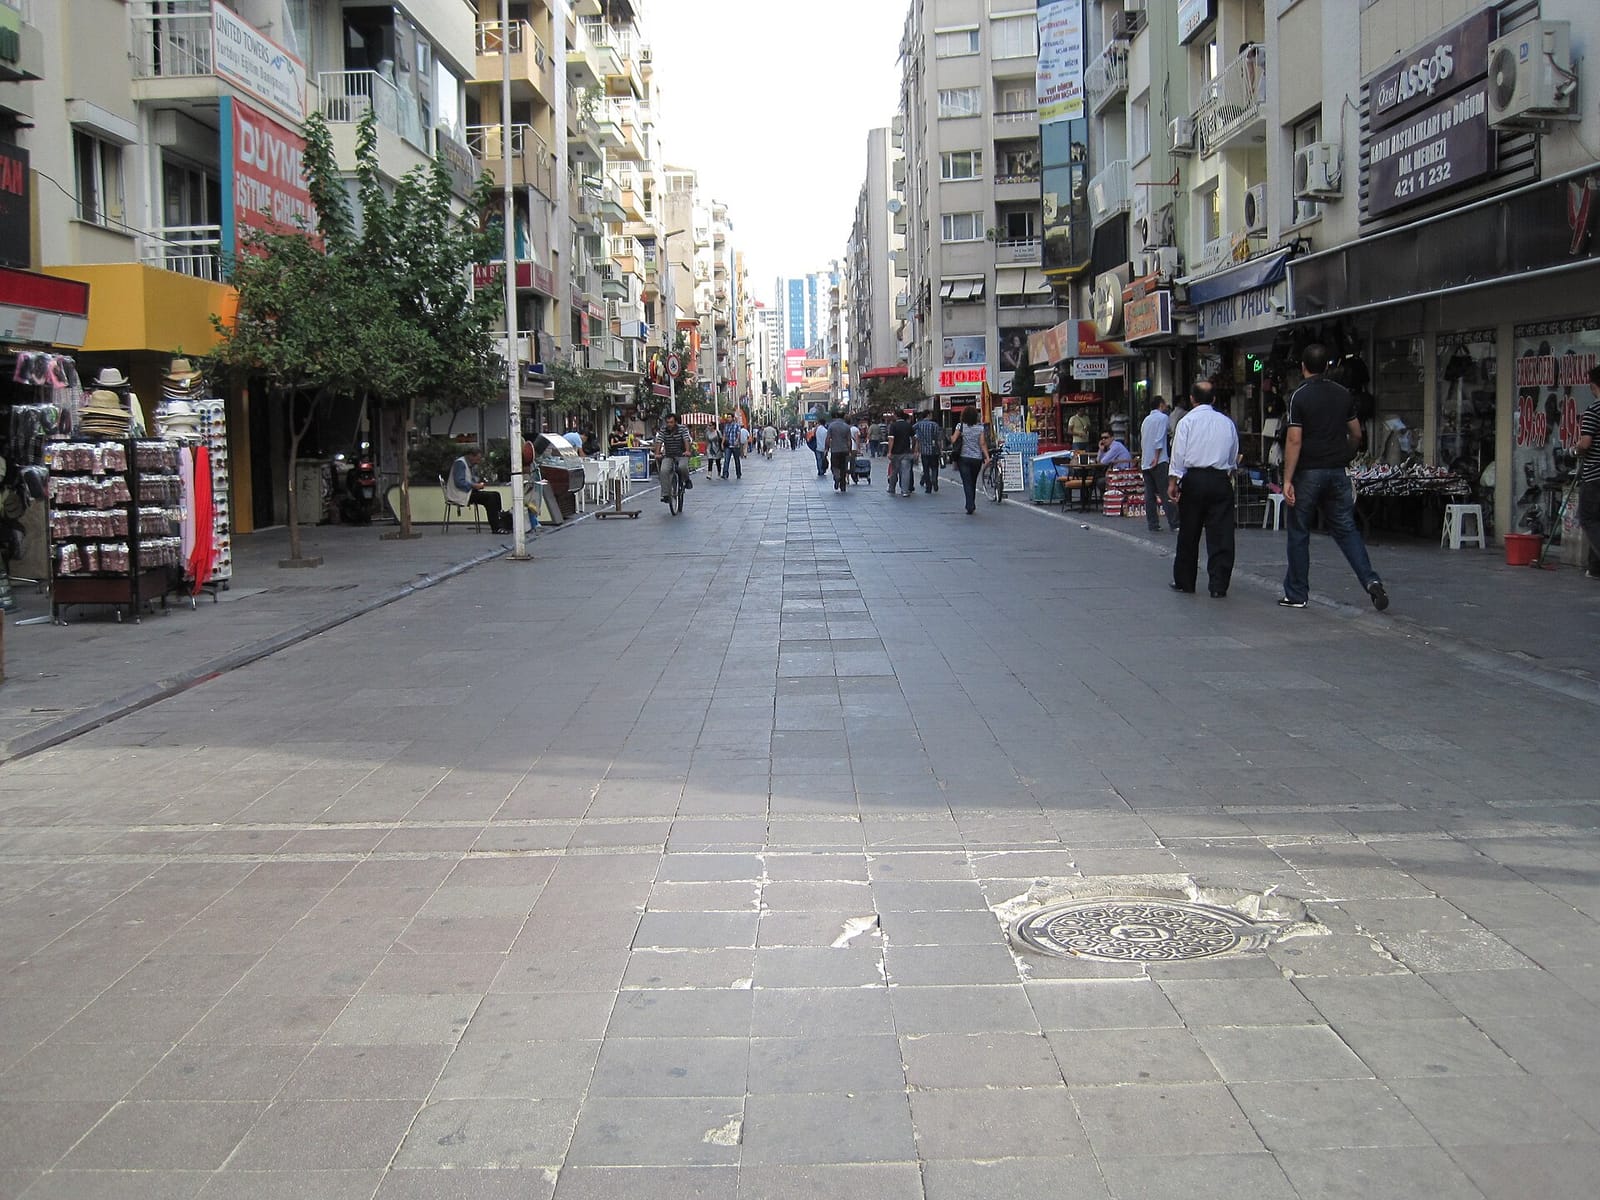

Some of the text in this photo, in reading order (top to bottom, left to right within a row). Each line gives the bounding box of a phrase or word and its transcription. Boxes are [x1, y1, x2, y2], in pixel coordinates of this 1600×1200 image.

[215, 12, 270, 64] UNITED TOWERS
[1378, 81, 1397, 107] Özel
[1370, 138, 1391, 165] KADIN
[1391, 113, 1441, 156] HASTALIKLARI
[1452, 91, 1485, 126] DOĞUM
[240, 119, 315, 192] DUYME
[1398, 153, 1413, 177] DAL
[1394, 161, 1452, 198] 421 1 232
[1076, 362, 1106, 370] Canon
[1002, 379, 1013, 394] S
